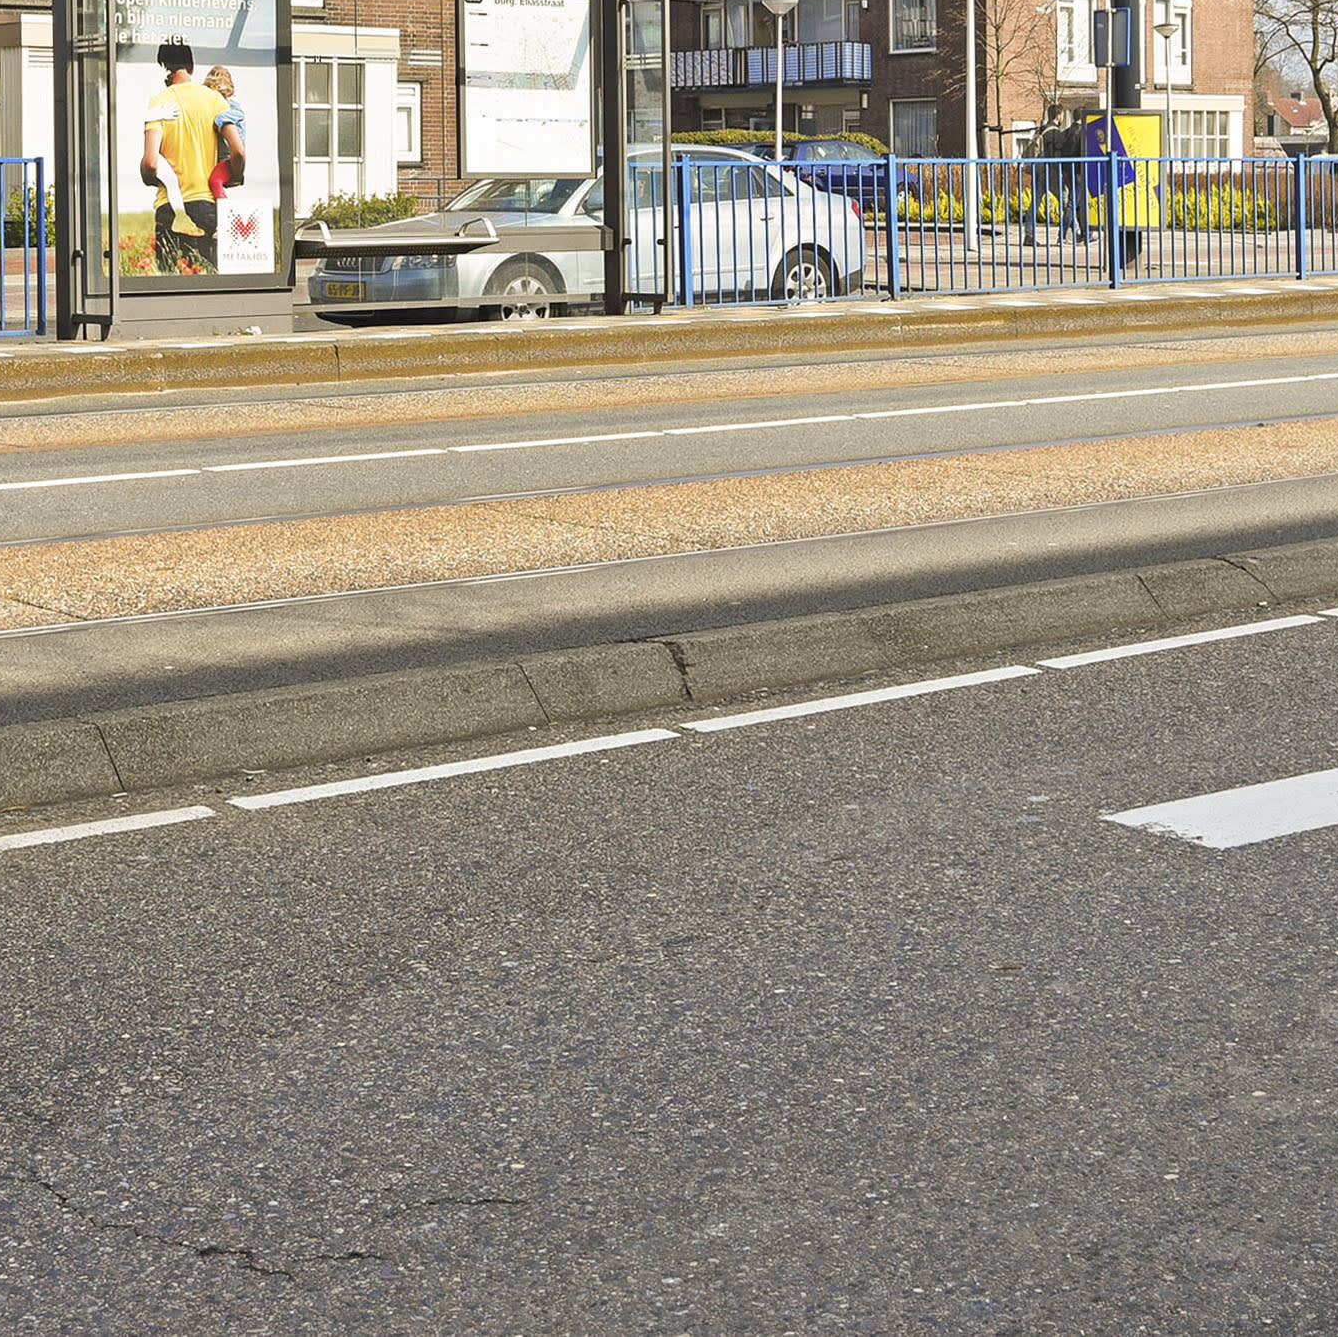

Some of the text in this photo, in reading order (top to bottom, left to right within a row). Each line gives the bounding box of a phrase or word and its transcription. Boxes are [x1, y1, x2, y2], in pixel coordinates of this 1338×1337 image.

[127, 8, 166, 28] bijna
[168, 12, 234, 29] niemand
[132, 29, 155, 44] het
